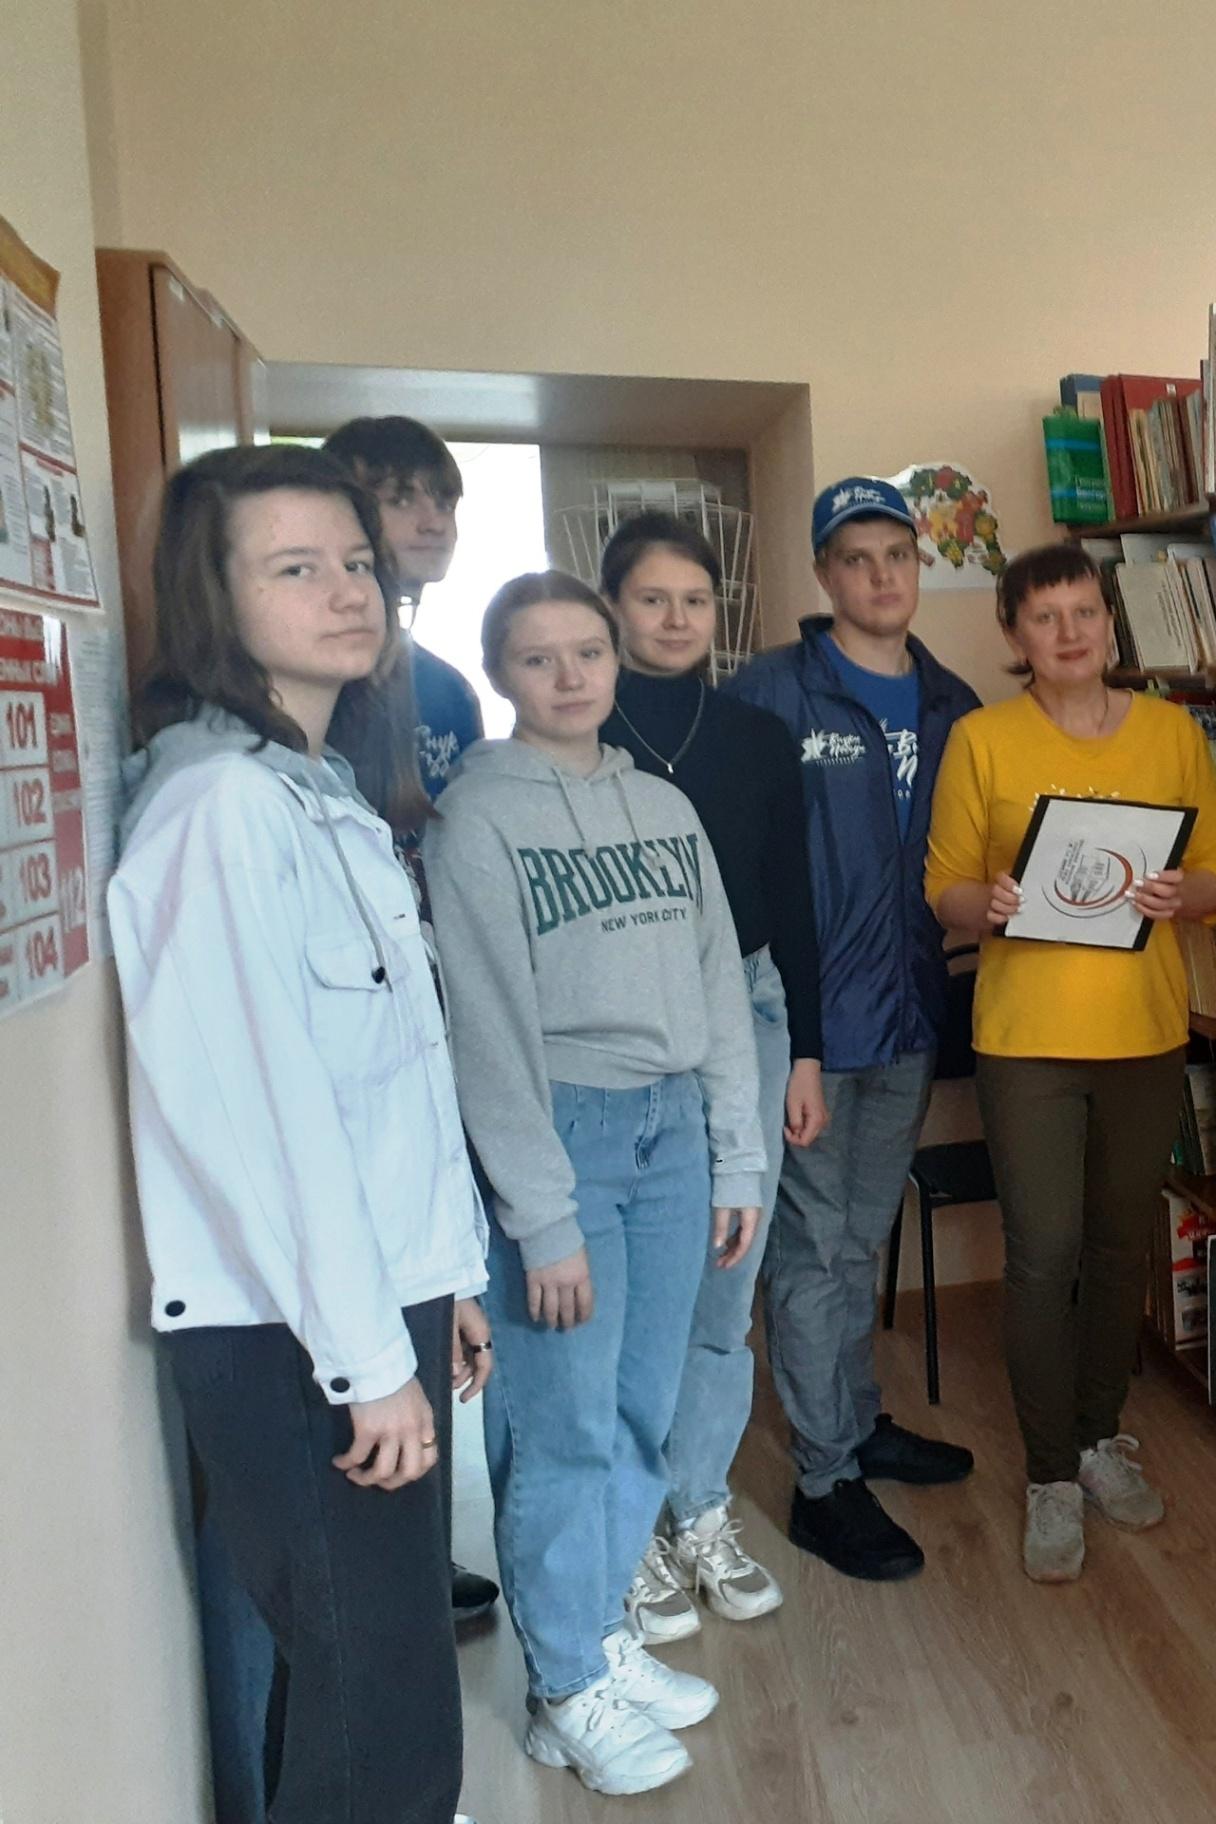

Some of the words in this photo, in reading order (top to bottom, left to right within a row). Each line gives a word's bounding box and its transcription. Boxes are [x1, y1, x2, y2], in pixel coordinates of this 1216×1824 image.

[6, 701, 39, 750] 101
[13, 777, 47, 827] 102
[20, 852, 51, 904] 103
[601, 915, 627, 932] NEW
[631, 910, 661, 928] YORK
[662, 907, 686, 922] CITY
[26, 925, 58, 981] 104
